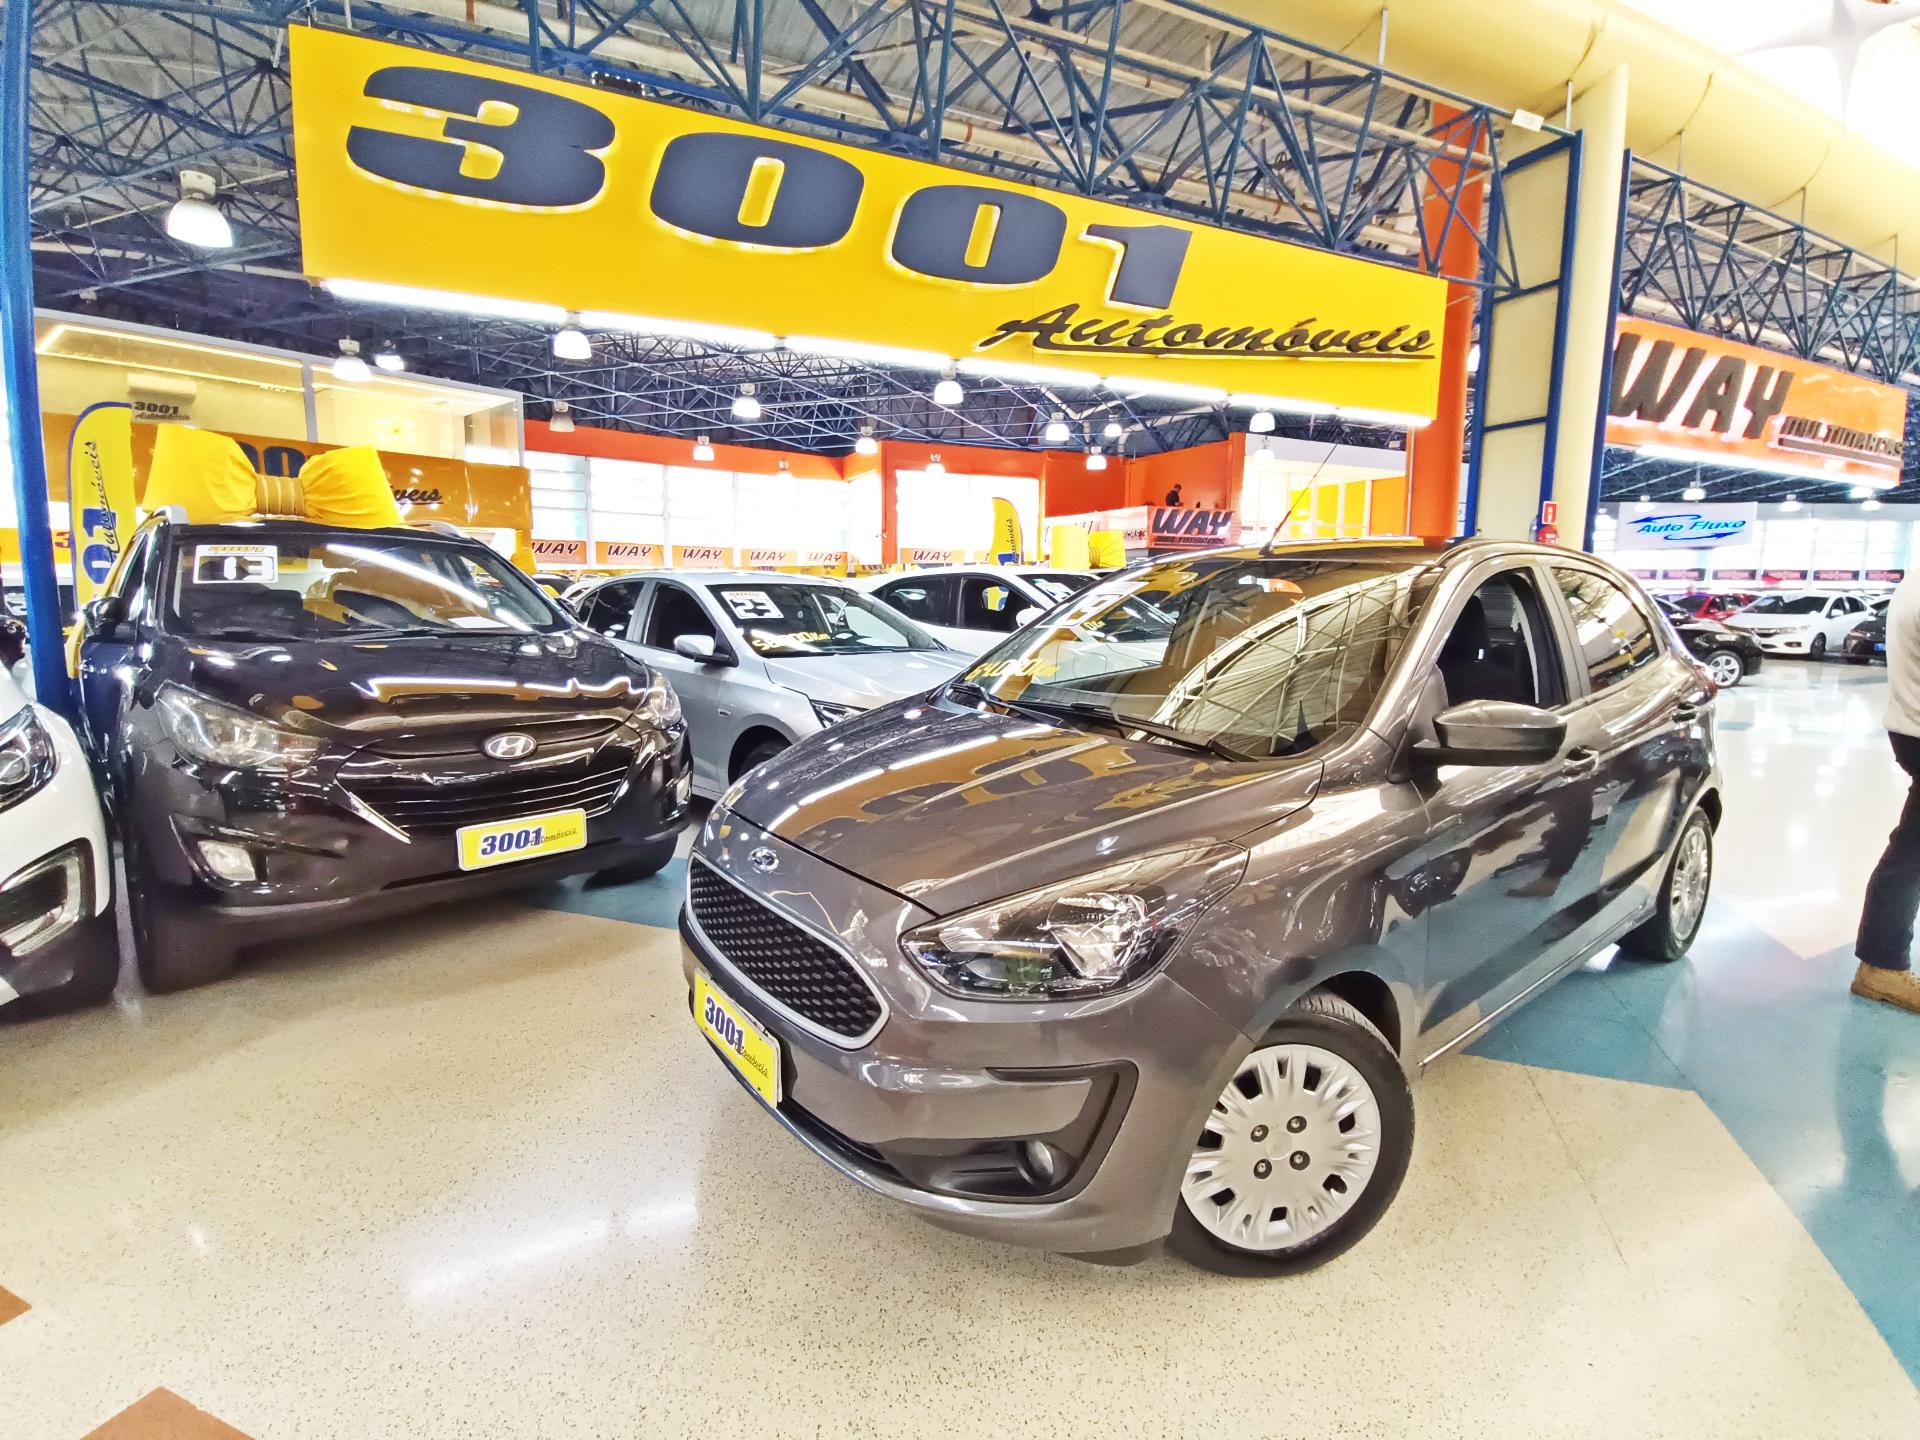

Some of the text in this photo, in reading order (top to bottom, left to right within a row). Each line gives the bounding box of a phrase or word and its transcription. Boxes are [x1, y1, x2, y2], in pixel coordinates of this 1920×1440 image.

[347, 66, 1192, 309] 3001
[977, 303, 1435, 359] Automóveis
[1609, 331, 1794, 439] WAY
[133, 401, 179, 415] 3001
[1152, 508, 1235, 535] WAY
[1637, 519, 1746, 533] Auto Fluxo
[531, 542, 579, 554] WAY
[607, 545, 652, 556] WAY
[682, 549, 722, 560] WAY
[750, 551, 787, 561] WAY
[912, 550, 953, 561] WAY
[481, 827, 543, 856] 3001
[705, 996, 743, 1052] 3001
